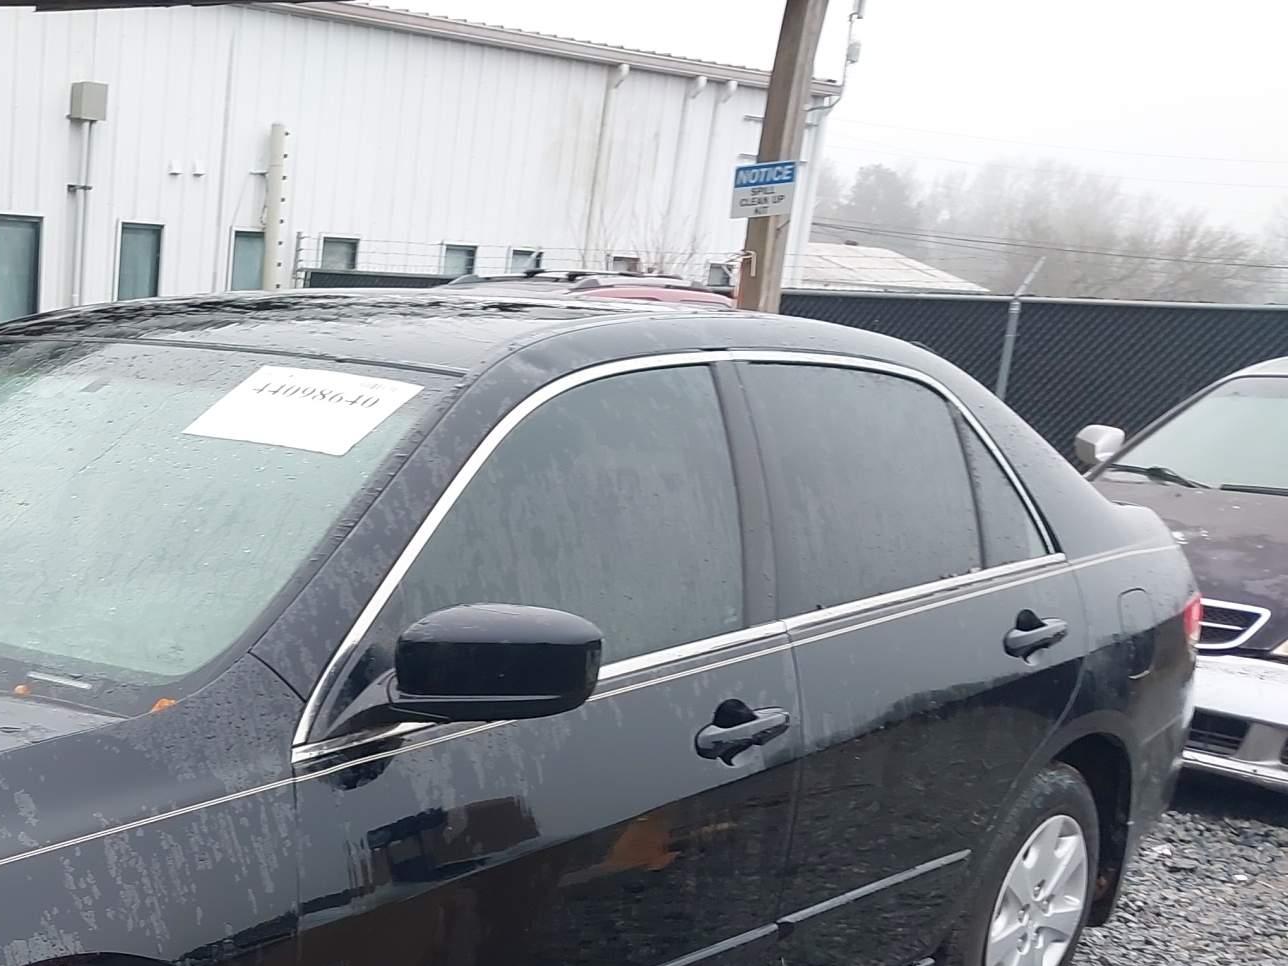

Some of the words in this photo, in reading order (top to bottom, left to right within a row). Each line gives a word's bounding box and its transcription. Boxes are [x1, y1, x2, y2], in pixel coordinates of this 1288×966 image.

[736, 165, 793, 184] NOTICE
[751, 186, 775, 196] SPILL
[740, 196, 769, 207] CLEAN
[771, 194, 785, 205] UP
[251, 382, 381, 409] 44098640
